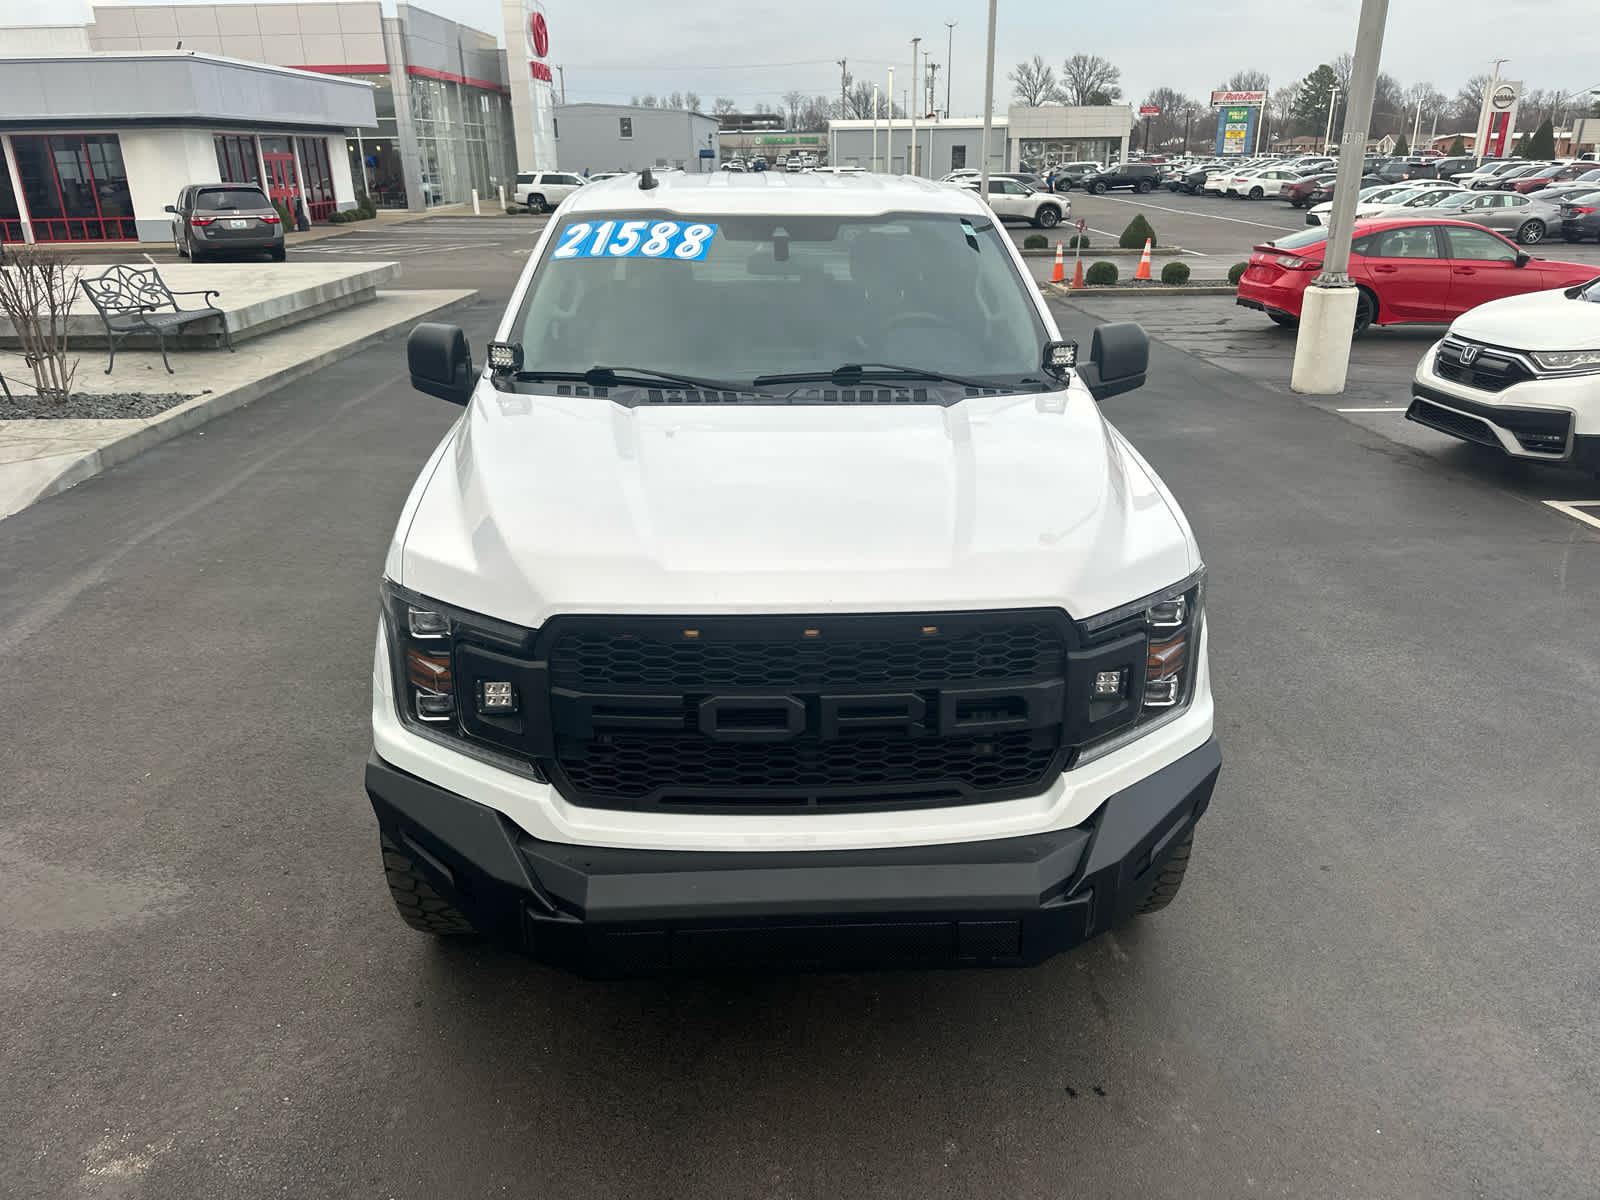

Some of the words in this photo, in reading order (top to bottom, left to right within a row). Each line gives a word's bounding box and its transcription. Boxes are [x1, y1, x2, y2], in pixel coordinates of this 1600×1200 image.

[1224, 92, 1263, 101] AutoZone
[553, 221, 714, 260] 21588
[553, 680, 1062, 740] FORD
